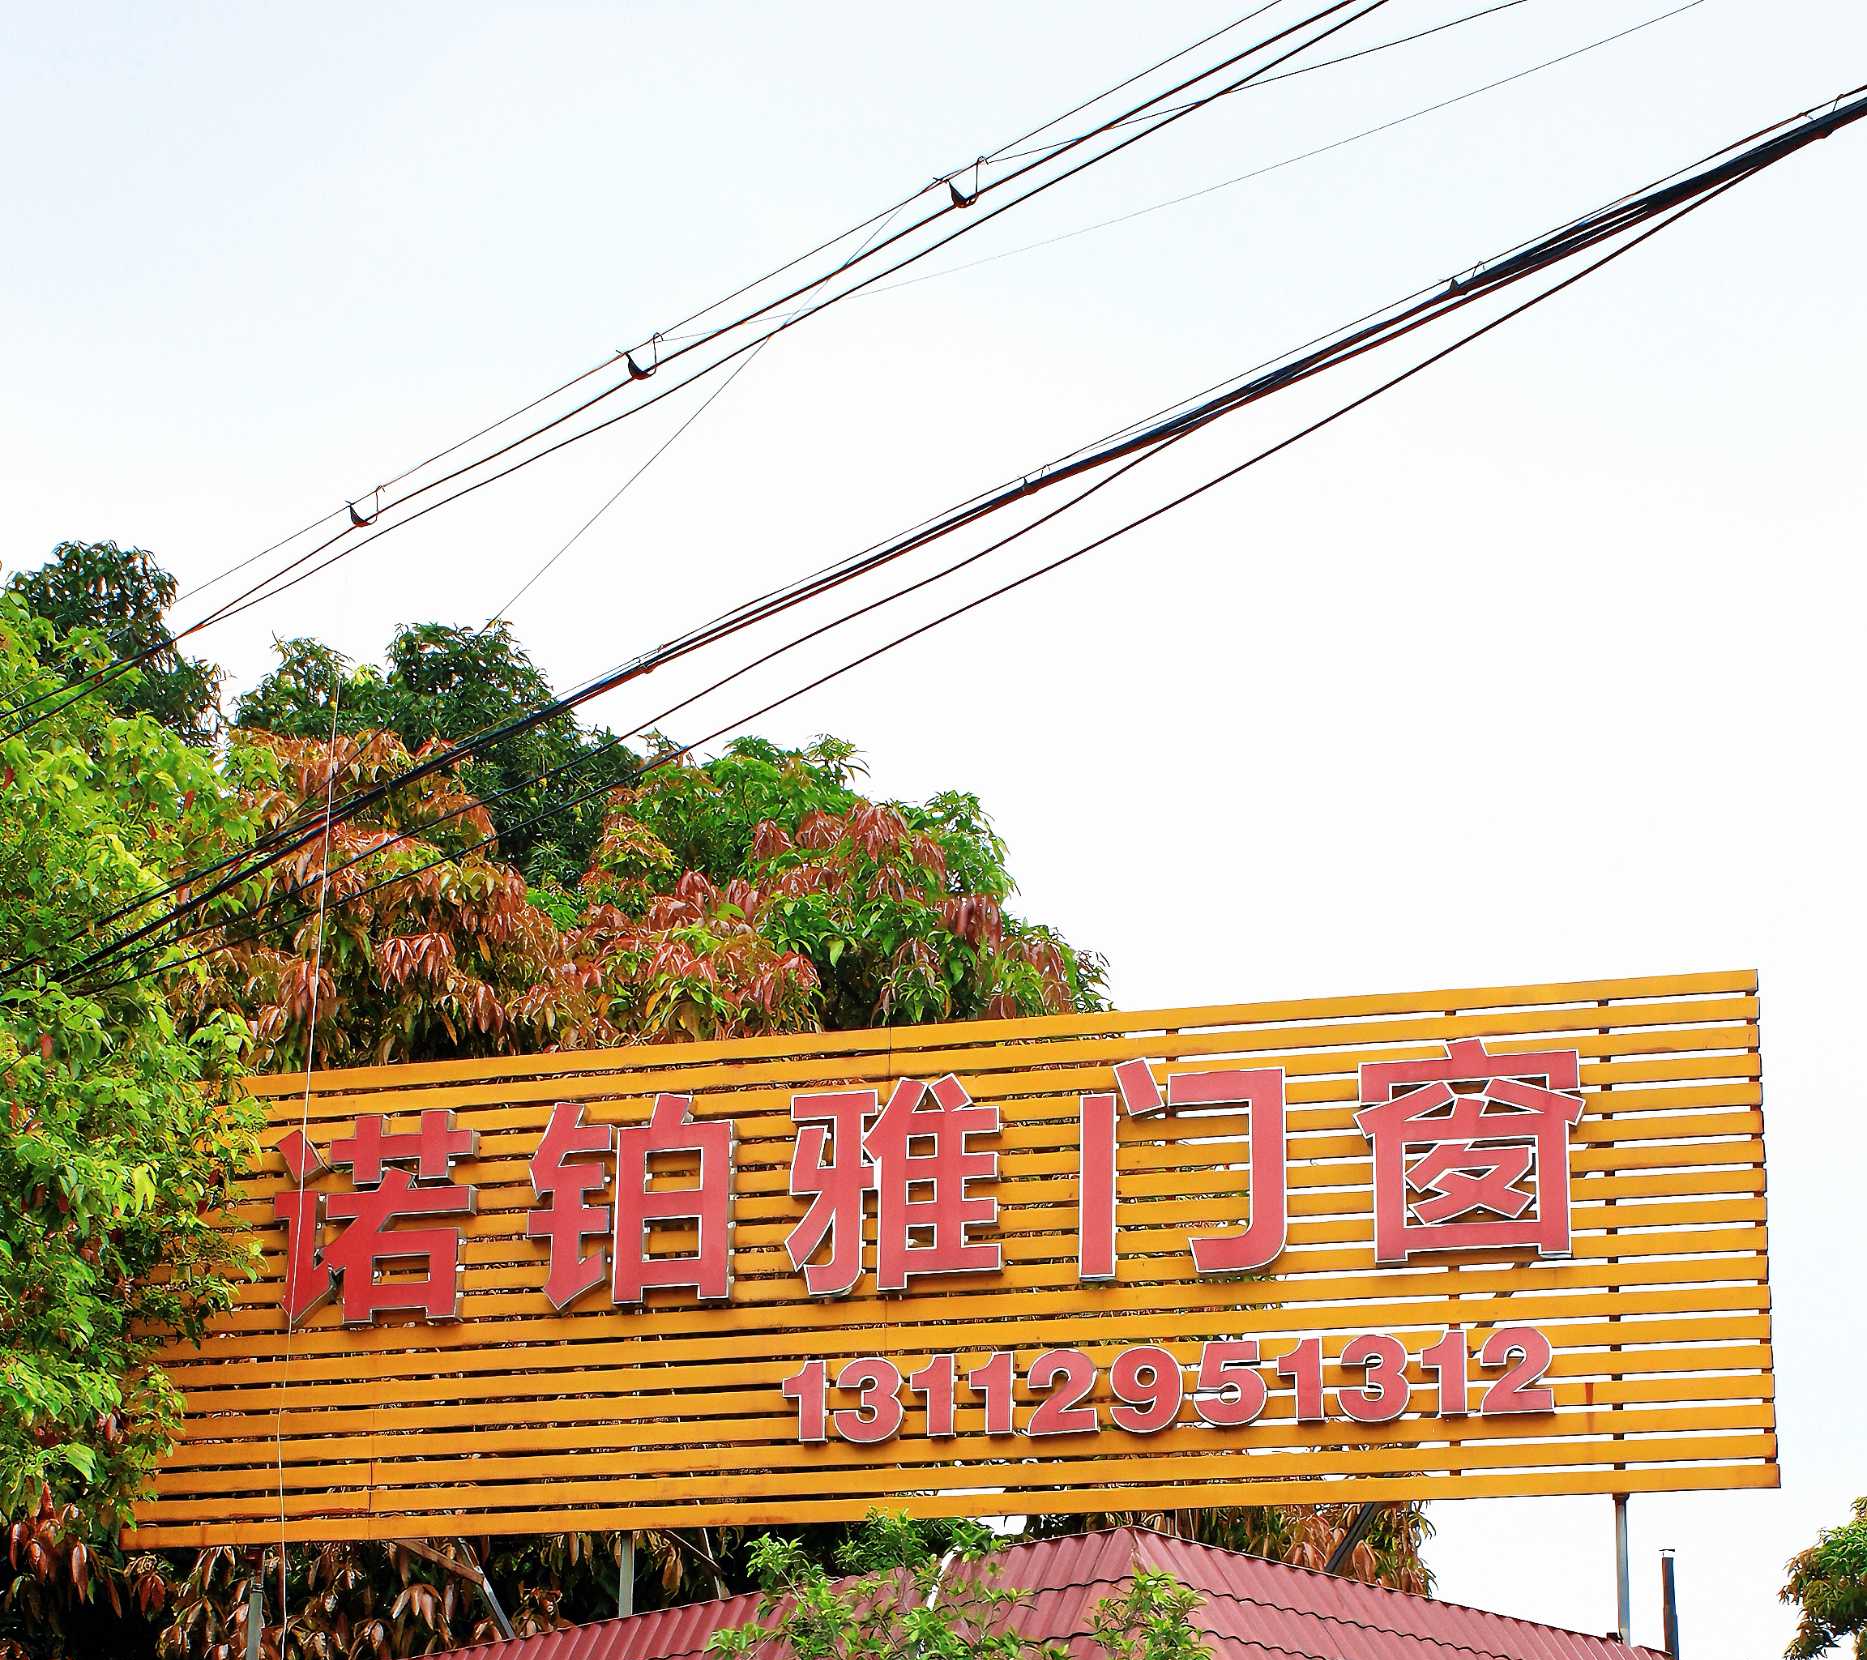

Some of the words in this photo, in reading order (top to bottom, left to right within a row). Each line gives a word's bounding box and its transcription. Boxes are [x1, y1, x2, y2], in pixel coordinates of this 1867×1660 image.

[275, 1037, 1586, 1329] 诺铂雅门窗
[782, 1325, 1556, 1445] 13112951312
